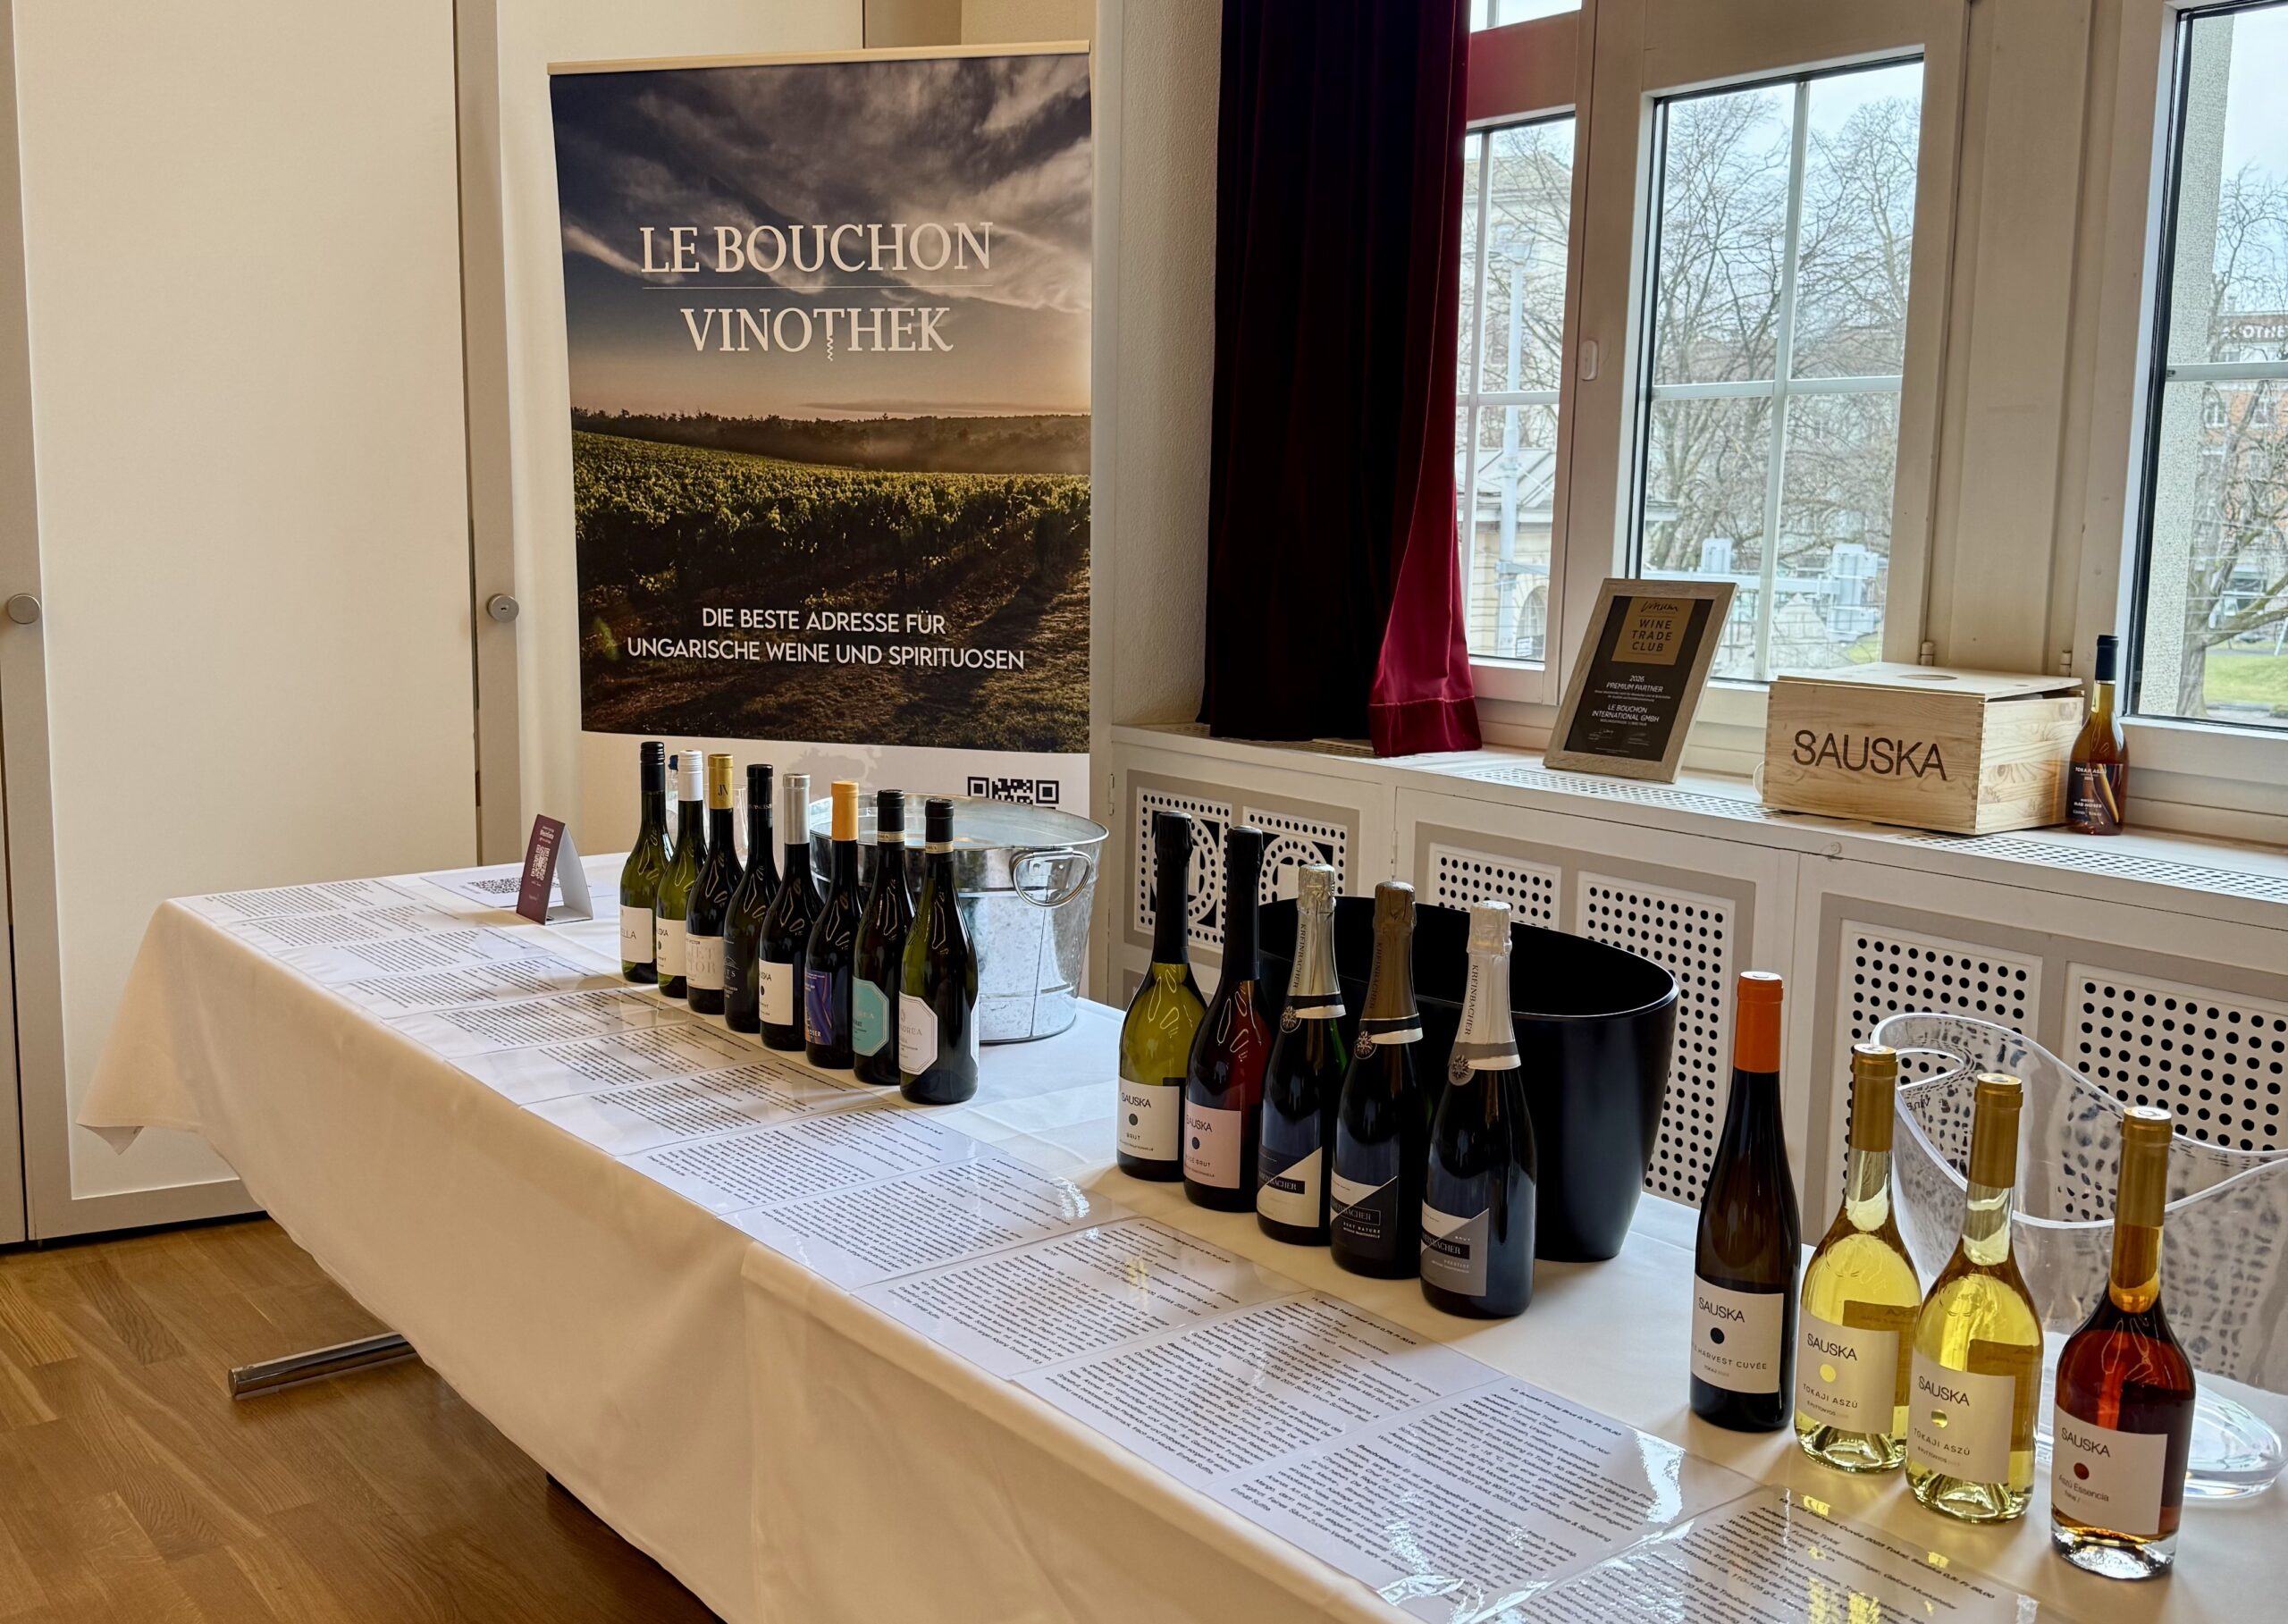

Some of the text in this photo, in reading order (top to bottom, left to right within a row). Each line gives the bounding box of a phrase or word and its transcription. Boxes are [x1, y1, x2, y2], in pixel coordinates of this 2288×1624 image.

[641, 221, 993, 273] LE BOUCHON
[680, 307, 953, 361] VINOTHEK
[702, 608, 946, 635] DIE BESTE ADRESSE FÜR
[1639, 618, 1672, 629] WINE
[1631, 630, 1672, 641] TRADE
[1632, 642, 1663, 652] CLUB
[627, 636, 1024, 670] UNGARISCHE WEINE UND SPIRITUOSEN
[1606, 682, 1663, 693] PREMIUM PARTNER
[1592, 711, 1638, 720] INTERNATIONAL
[1616, 704, 1647, 713] BOUCHON
[1793, 729, 1947, 781] SAUSKA
[1292, 923, 1307, 989] KREINBACHER
[1368, 942, 1384, 1009] KREINBACHER
[1464, 964, 1479, 1036] KREINBACHER
[1122, 1092, 1151, 1108] SAUSKA
[1126, 1132, 1140, 1140] BRUT
[1186, 1115, 1212, 1132] SAUSKA
[1698, 1297, 1745, 1323] SAUSKA
[1698, 1348, 1732, 1366] HARVEST
[1736, 1360, 1767, 1370] CUVÉE
[1807, 1333, 1857, 1361] SAUSKA
[1803, 1384, 1858, 1409] TOKAJI ASZÚ
[1919, 1376, 1970, 1407] SAUSKA
[1914, 1427, 1971, 1456] TOKAJI ASZÚ
[2061, 1427, 2110, 1458] SAUSKA
[2074, 1483, 2109, 1502] Essencia
